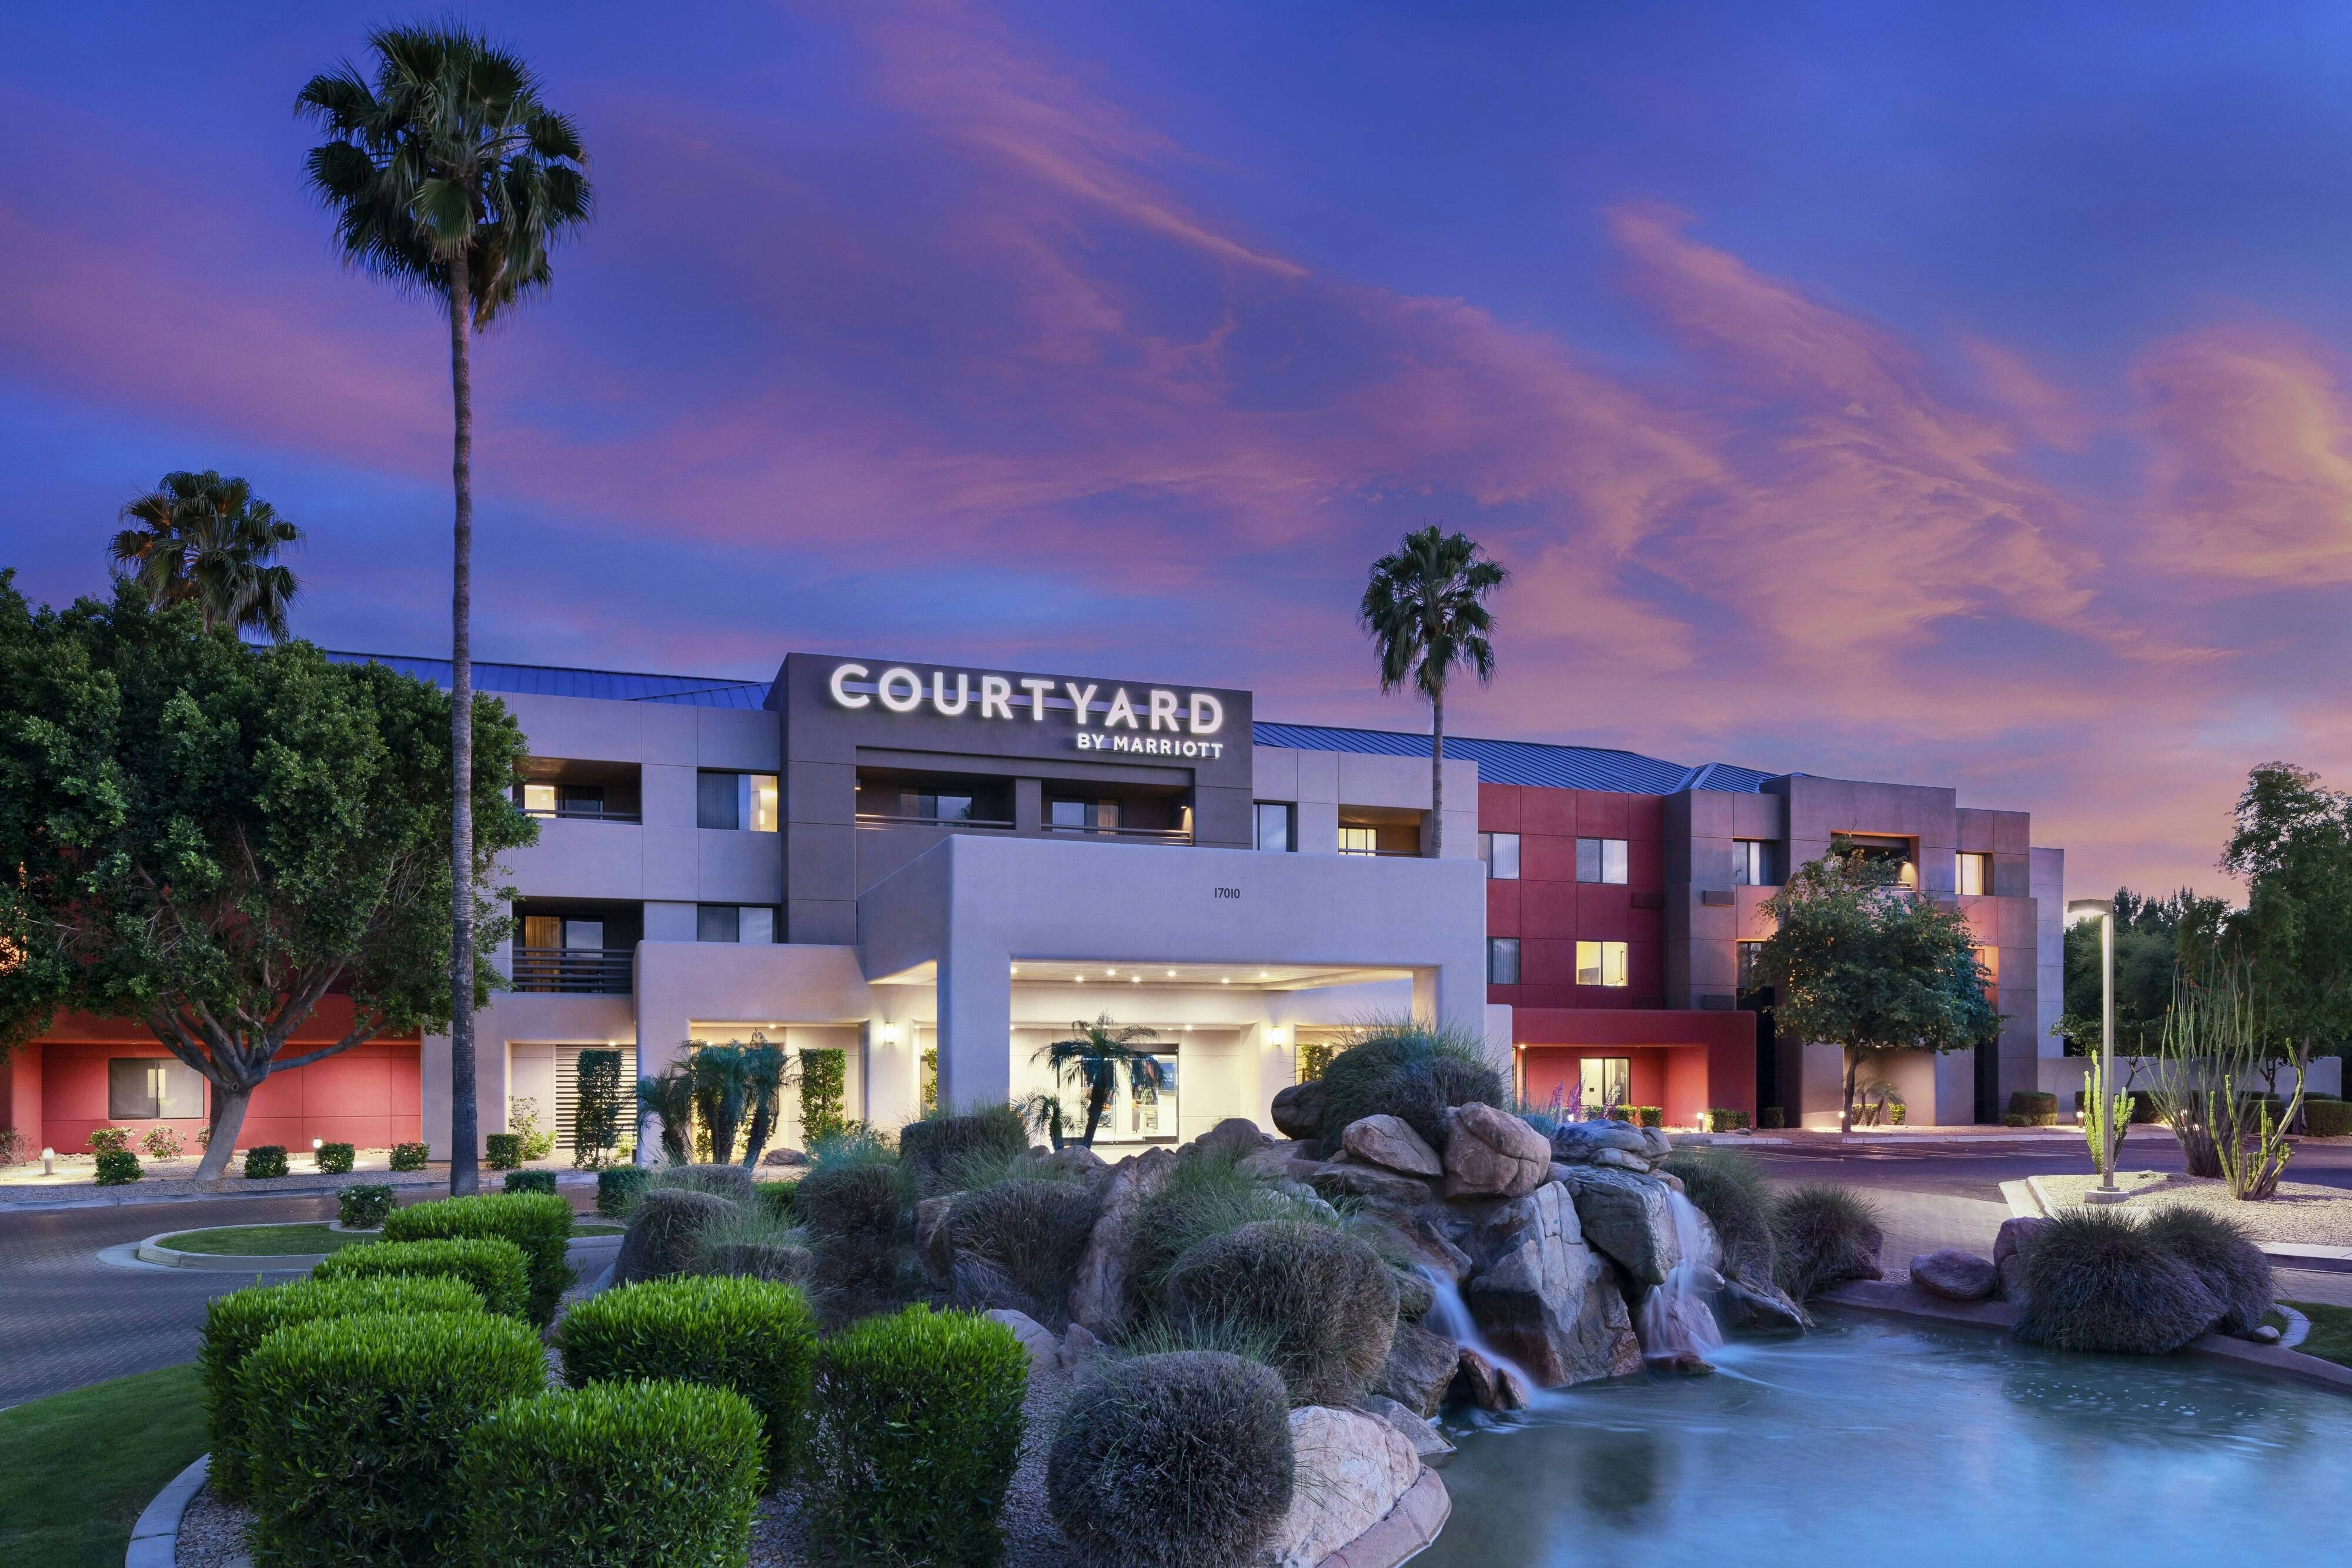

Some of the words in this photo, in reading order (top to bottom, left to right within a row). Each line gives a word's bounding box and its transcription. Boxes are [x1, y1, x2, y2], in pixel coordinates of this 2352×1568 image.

[831, 664, 1223, 733] COURTYARD
[1078, 733, 1104, 750] BY
[1114, 736, 1223, 758] MARRIOTT
[1214, 888, 1240, 898] 17010
